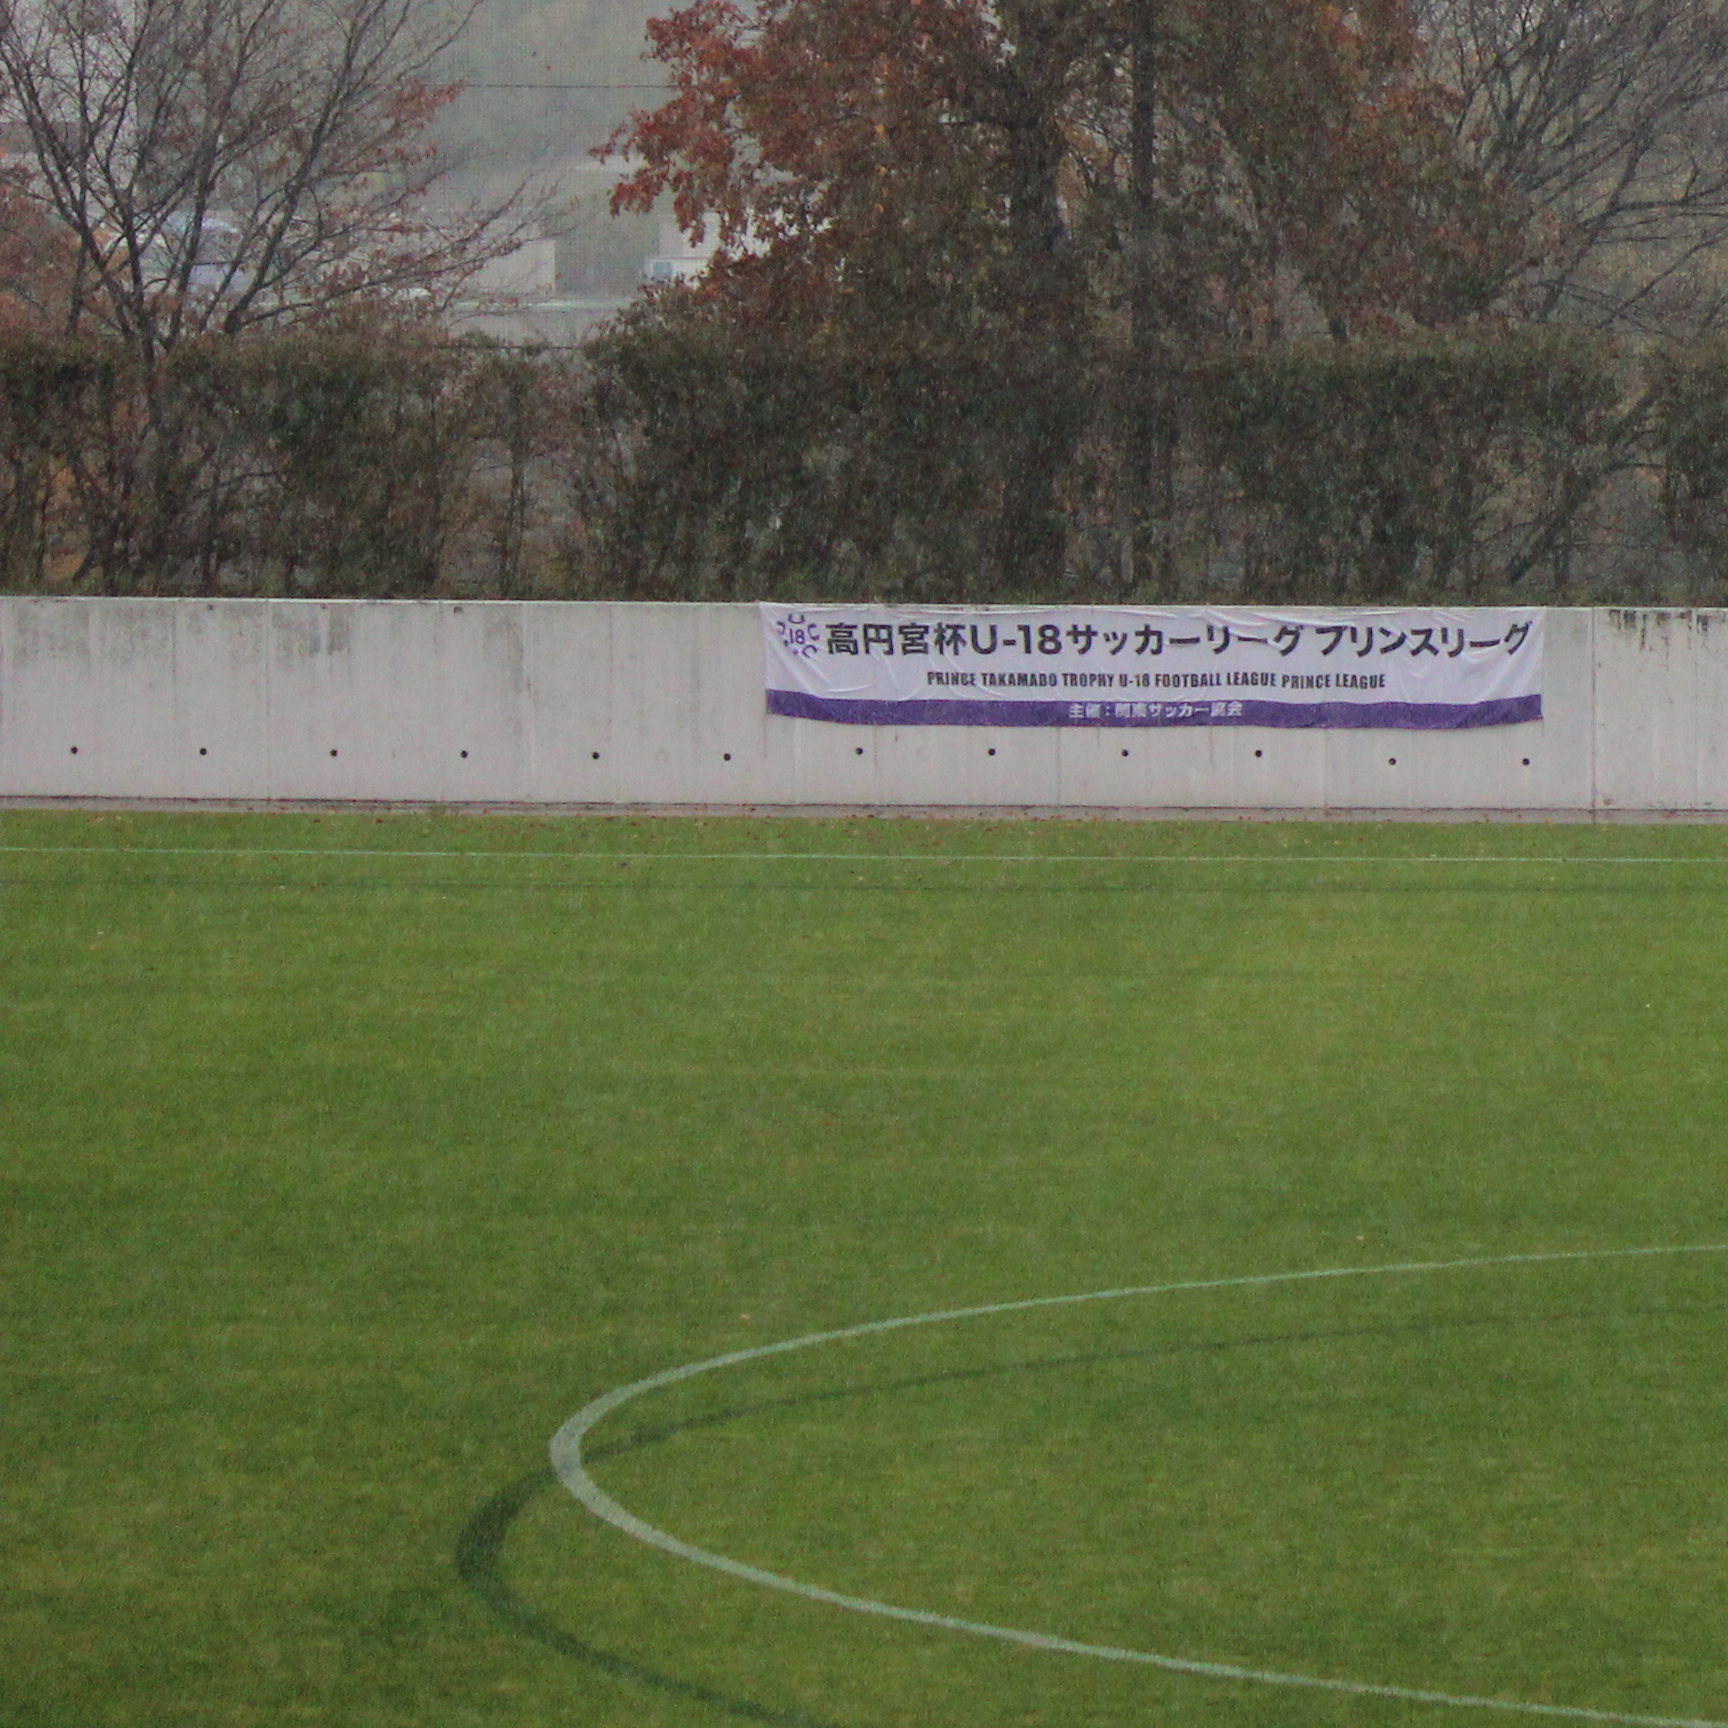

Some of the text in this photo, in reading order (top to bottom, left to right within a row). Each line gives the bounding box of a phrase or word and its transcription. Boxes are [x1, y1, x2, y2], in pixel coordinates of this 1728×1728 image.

[825, 622, 1303, 657] 高円宮杯U-18サッカーリーグ
[927, 671, 1387, 689] PRINCE TAKAMADO TROPHY U-18 FOOTBALL LEAGUE PRINCE LEAGUE
